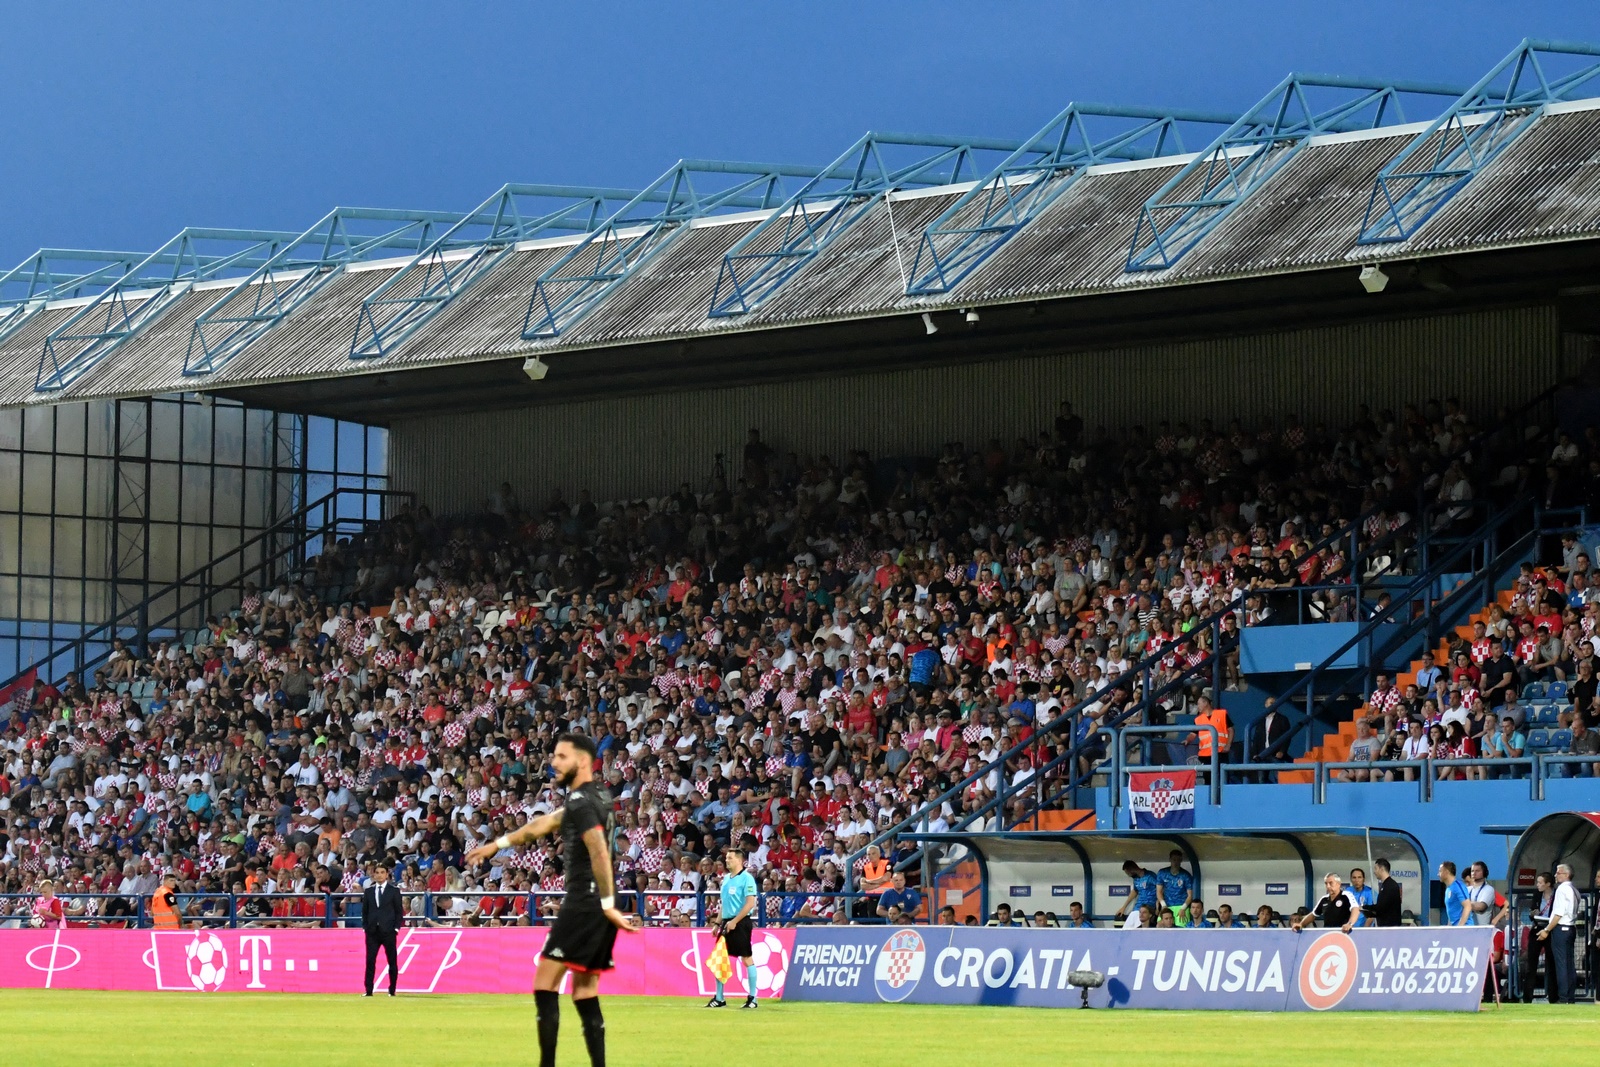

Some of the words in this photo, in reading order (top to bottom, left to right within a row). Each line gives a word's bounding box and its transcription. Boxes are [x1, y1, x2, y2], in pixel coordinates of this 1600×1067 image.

[793, 943, 878, 965] FRIENDLY
[1371, 940, 1479, 970] VARAŽDIN
[799, 966, 861, 987] MATCH
[933, 946, 1093, 990] CROATIA
[1128, 949, 1285, 993] TUNISIA
[1357, 971, 1479, 994] 11.06.2019
